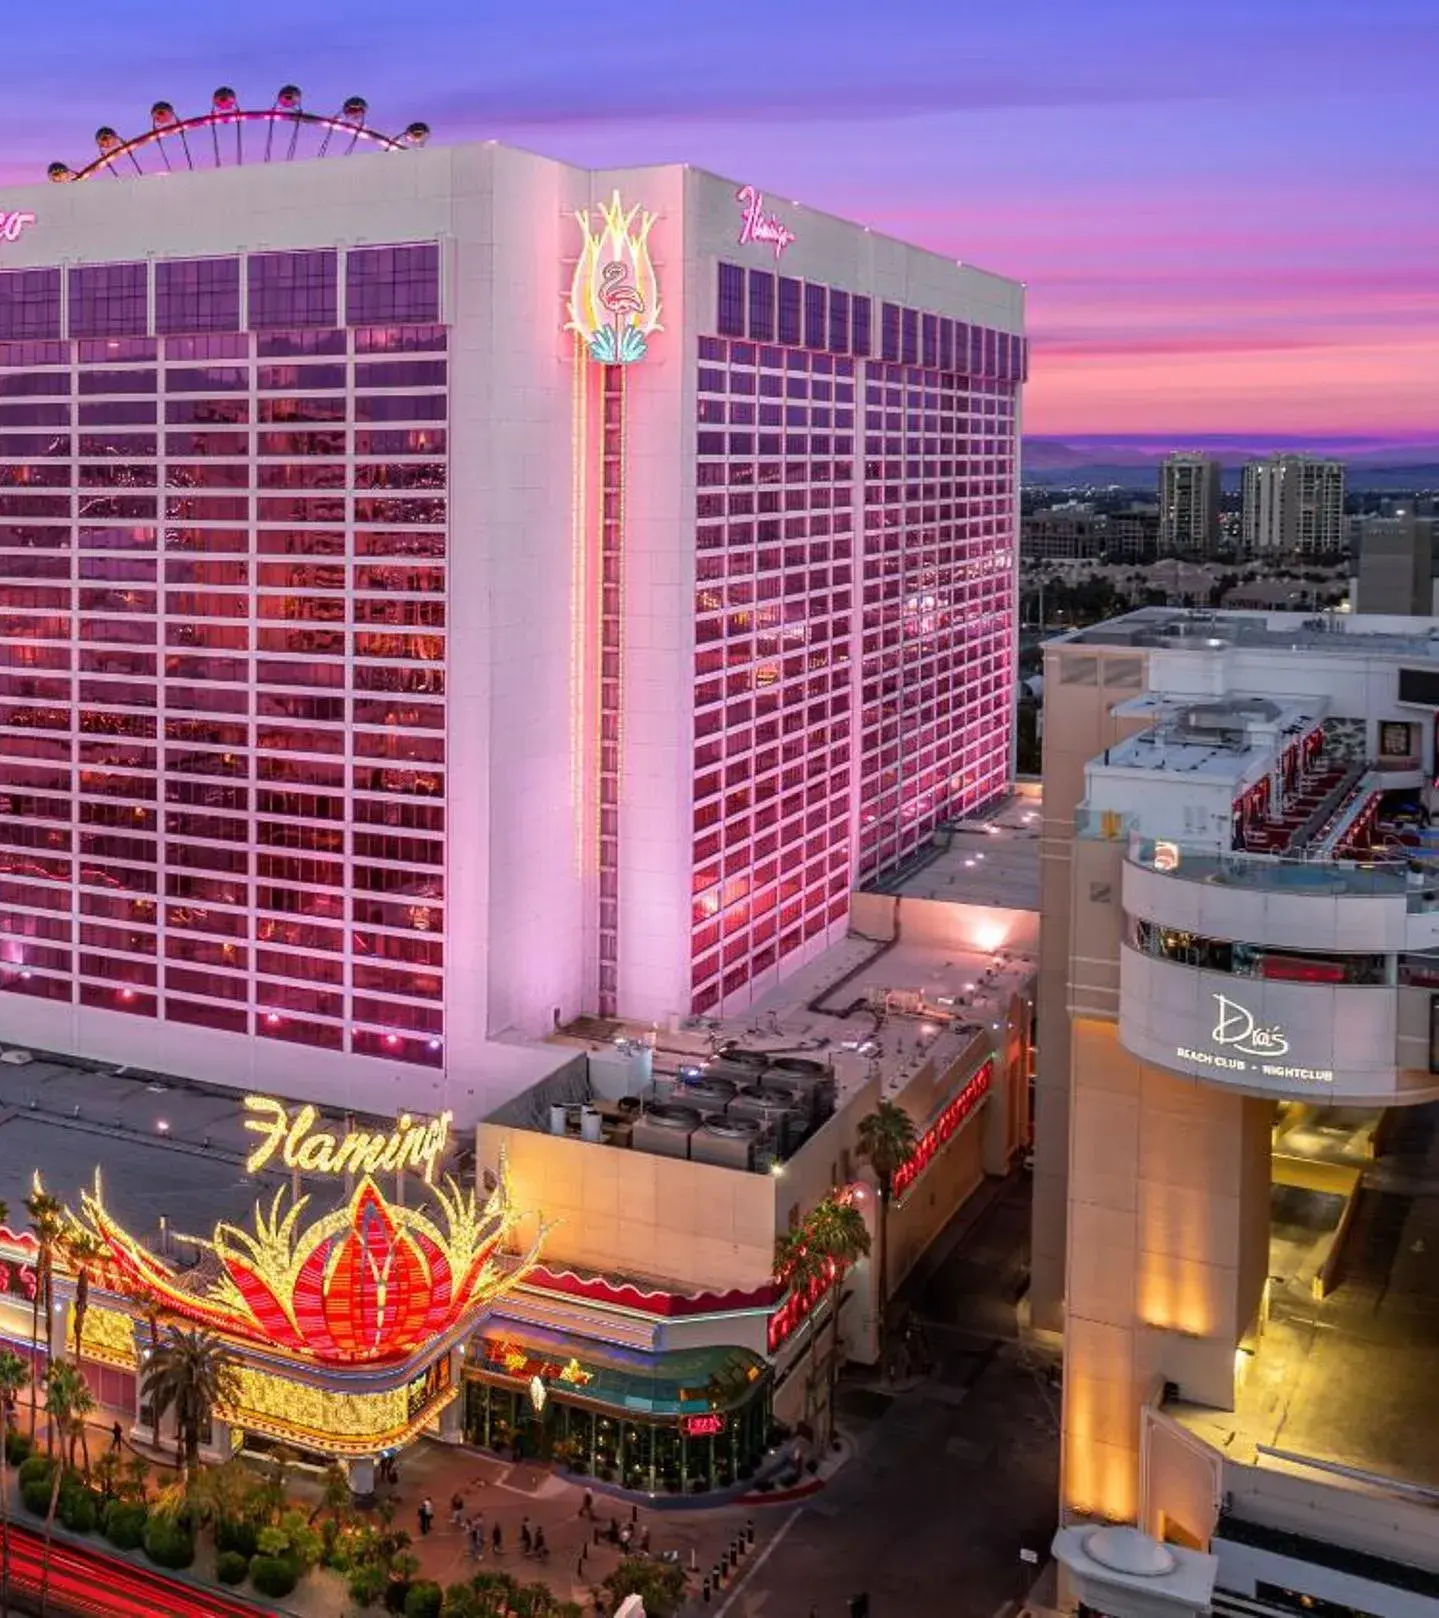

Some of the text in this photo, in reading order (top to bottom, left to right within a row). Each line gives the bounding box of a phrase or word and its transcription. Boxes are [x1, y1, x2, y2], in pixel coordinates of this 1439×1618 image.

[1177, 1047, 1334, 1082] BEACH CLUB NIGHTCLUB
